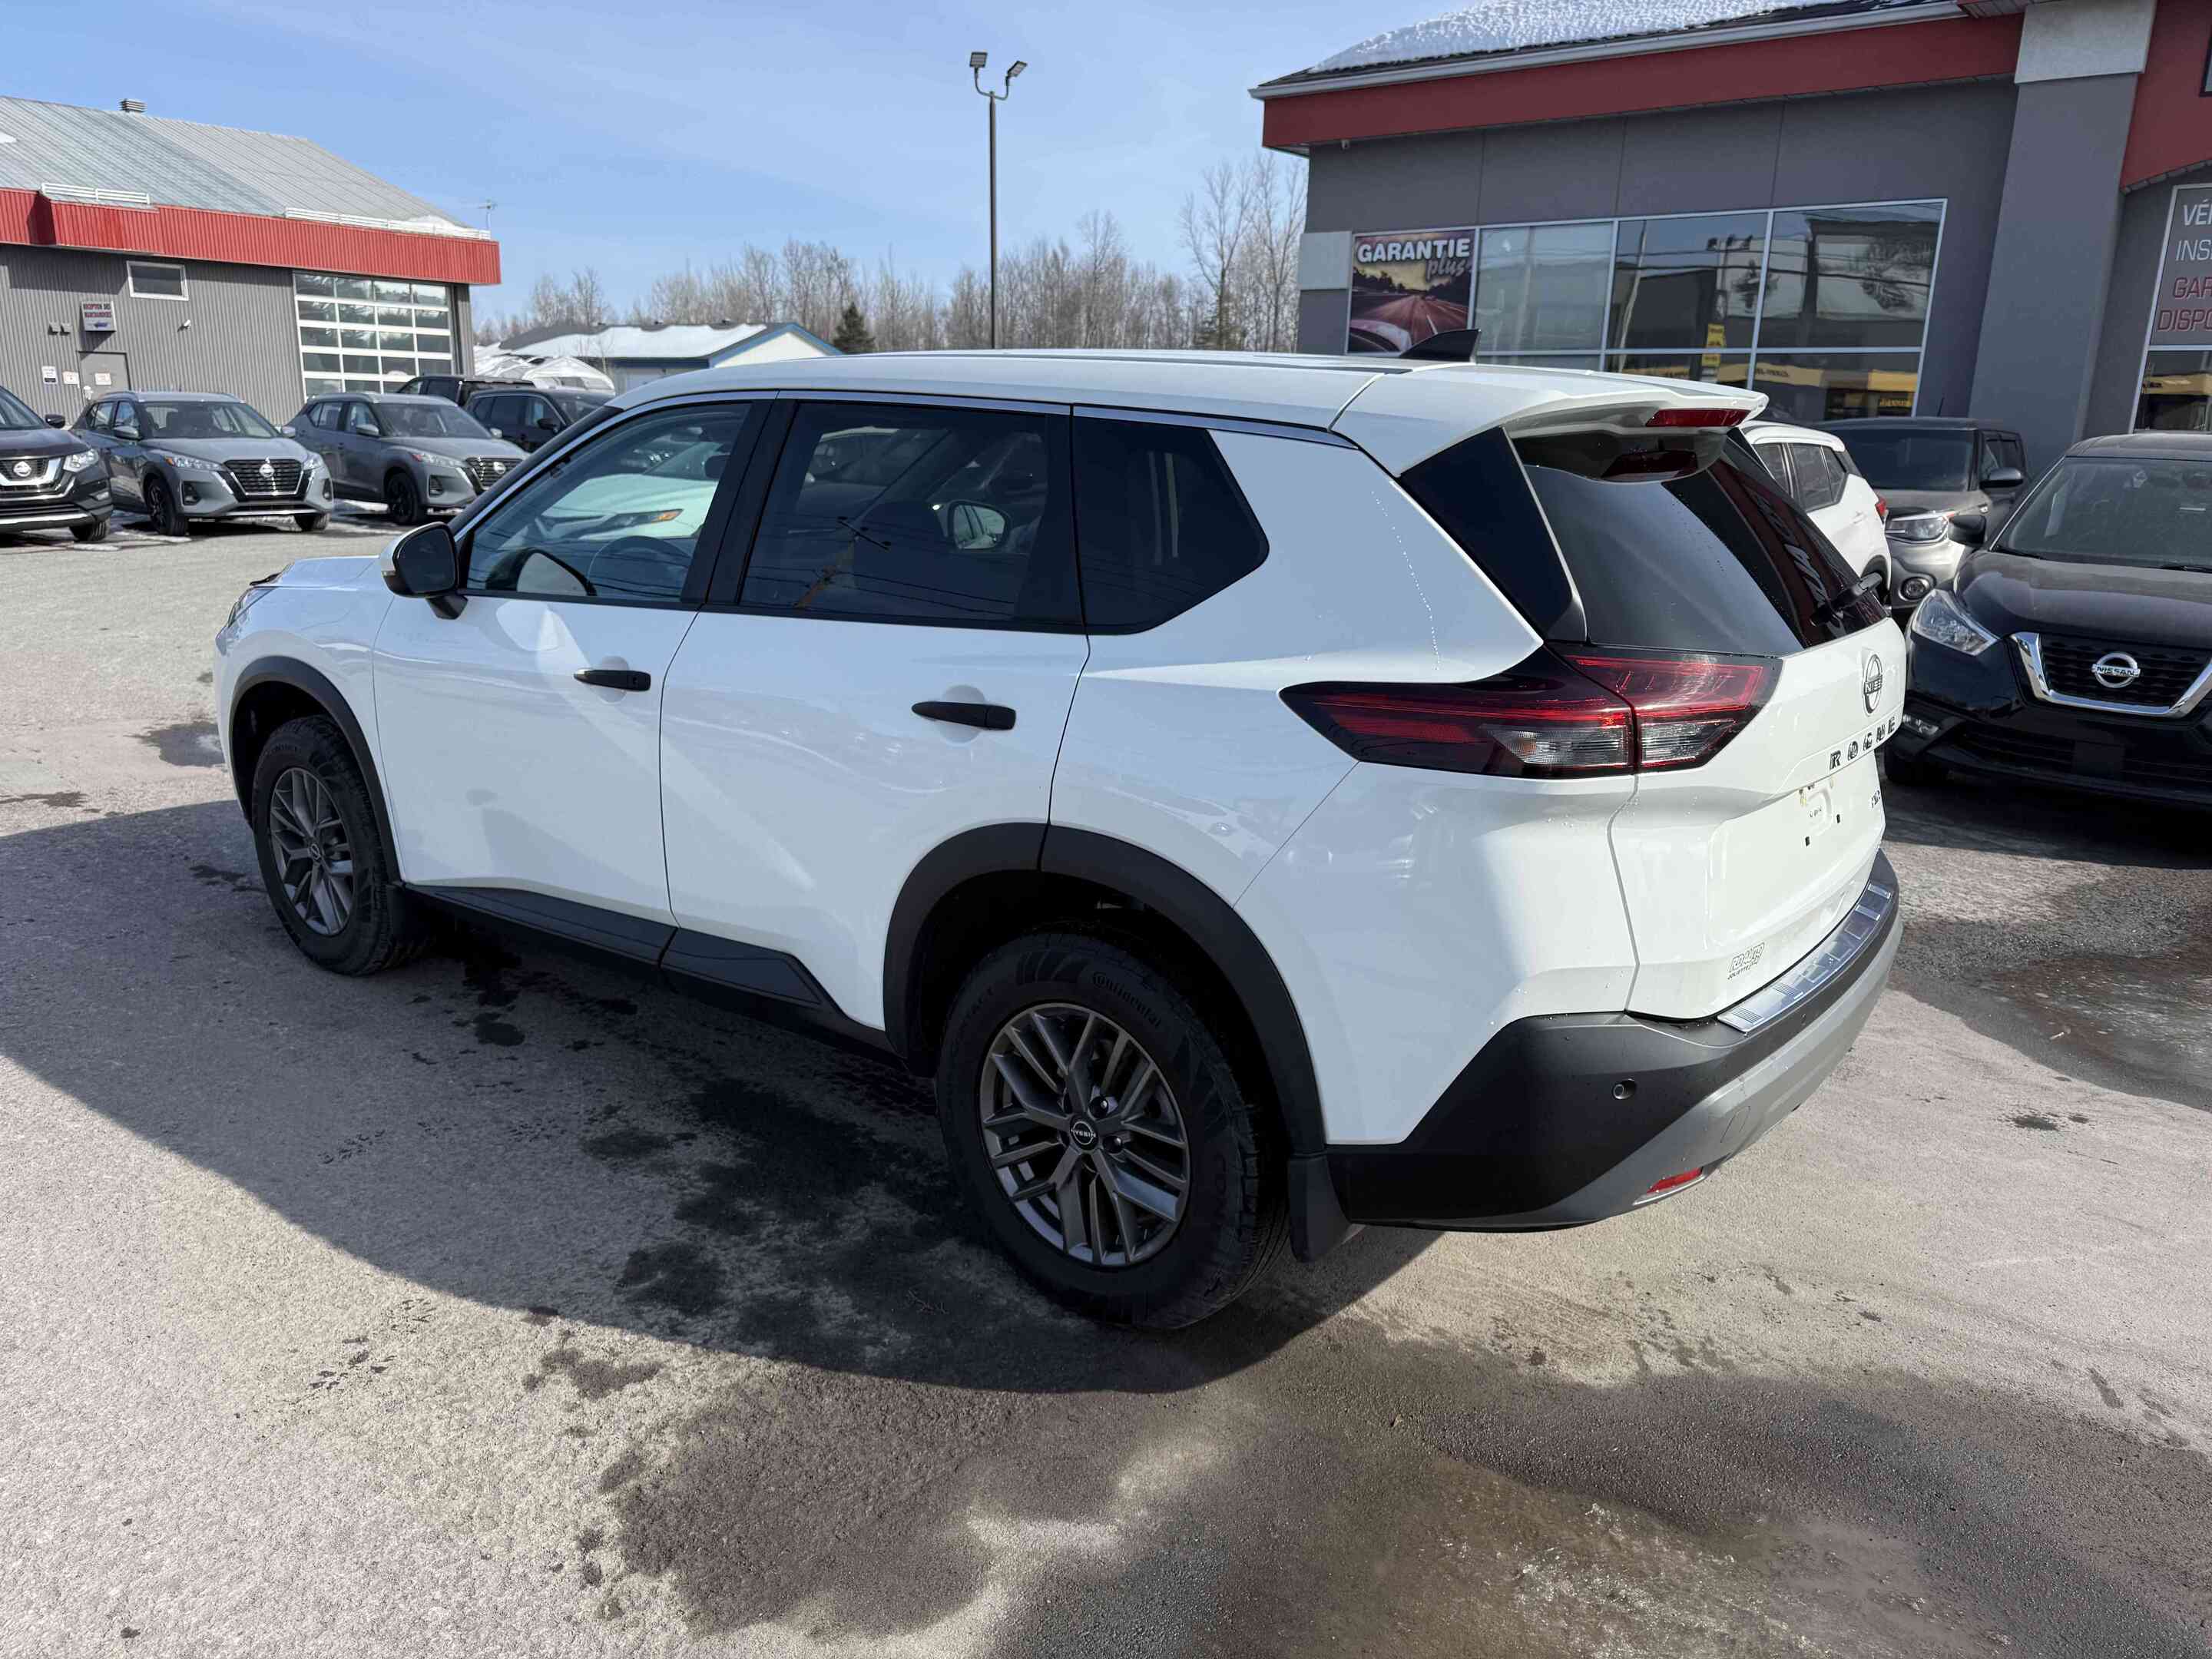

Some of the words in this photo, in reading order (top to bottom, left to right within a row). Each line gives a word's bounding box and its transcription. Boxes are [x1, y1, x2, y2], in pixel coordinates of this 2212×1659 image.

[1357, 238, 1470, 263] GARANTIE
[2176, 239, 2212, 260] INS
[1426, 254, 1466, 281] plus
[2097, 666, 2134, 676] NISSAN
[1829, 717, 1895, 770] ROGUE
[1092, 971, 1162, 1027] Continental
